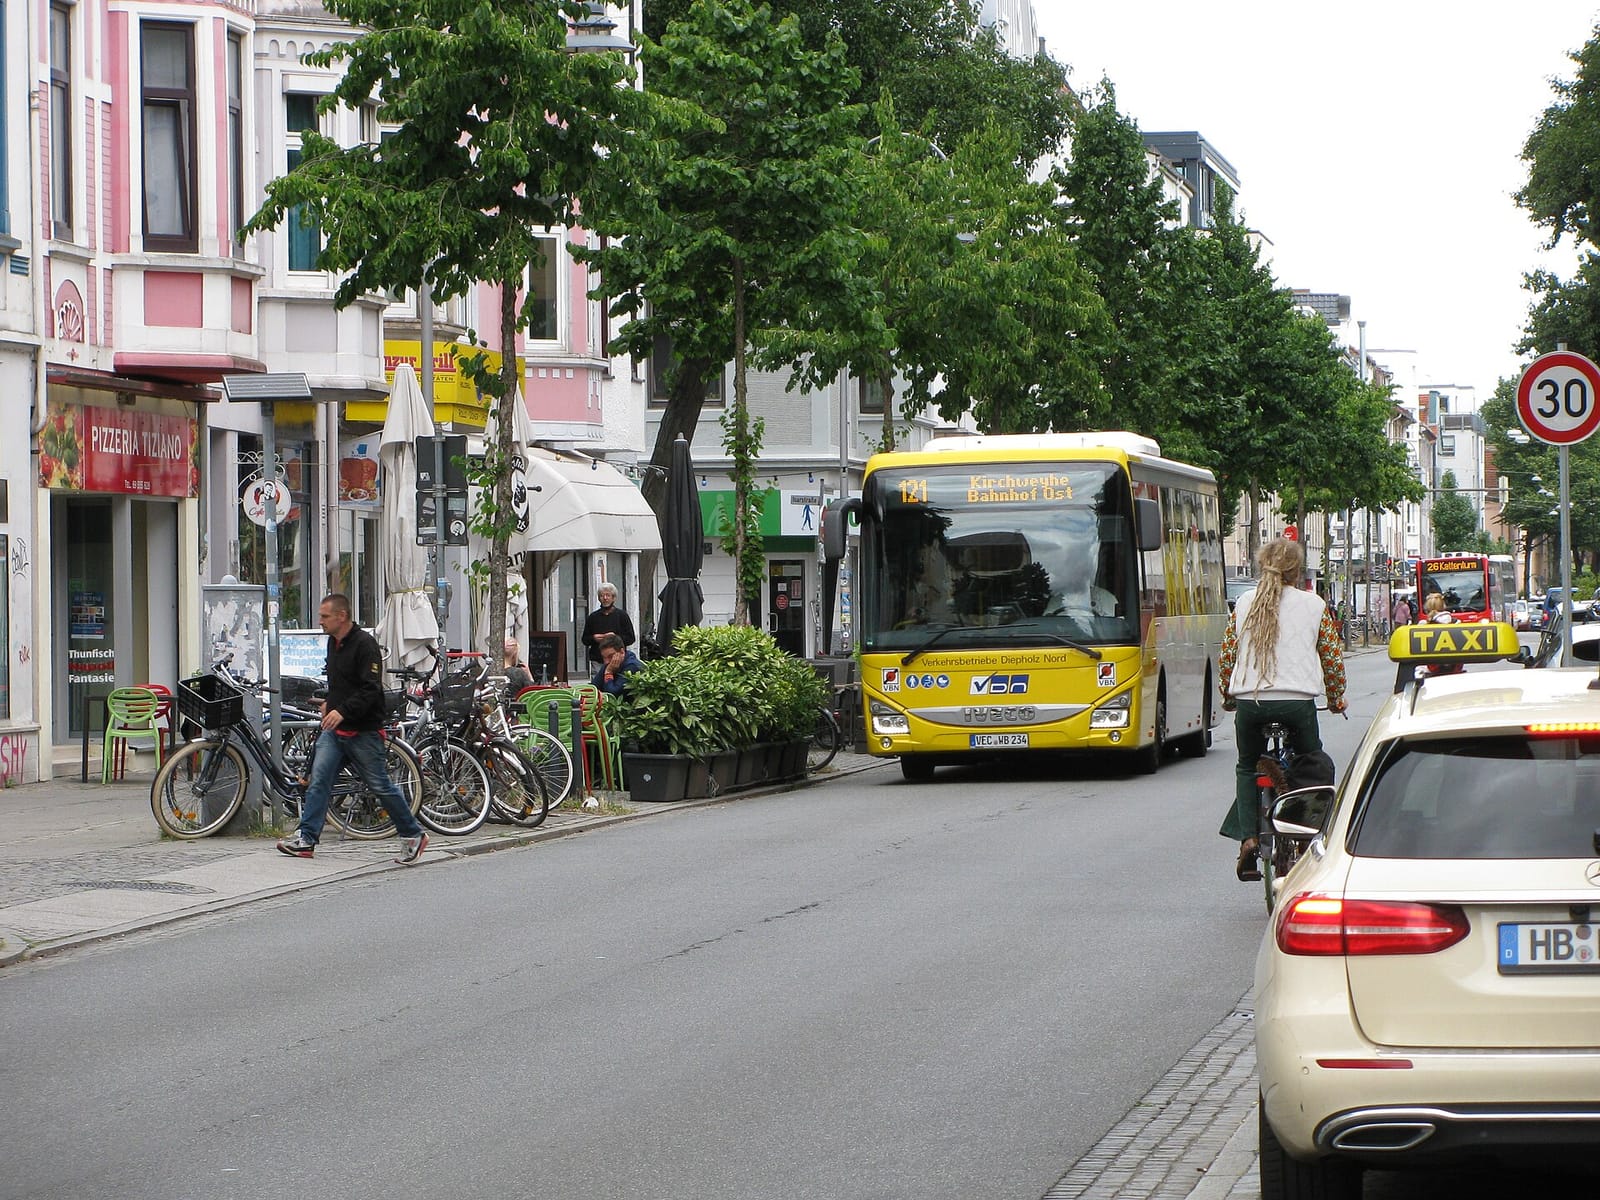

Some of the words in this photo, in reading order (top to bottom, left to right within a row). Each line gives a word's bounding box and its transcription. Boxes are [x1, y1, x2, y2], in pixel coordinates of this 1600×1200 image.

[1537, 378, 1587, 418] 30
[91, 425, 140, 456] PIZZERIA
[142, 431, 182, 460] TIZIANO
[898, 479, 928, 503] 121
[970, 474, 1069, 489] Kirchweyhe
[967, 488, 1037, 503] Bahnhof
[1043, 486, 1073, 500] Ost
[1427, 561, 1440, 572] 26
[1413, 629, 1494, 652] TAXI
[69, 648, 115, 659] Thunfisch
[921, 656, 998, 667] Verkehrsbetriebe
[1001, 654, 1041, 666] Diepholz
[1043, 653, 1067, 663] Nord
[69, 673, 115, 683] Fantasie
[883, 683, 899, 692] VBN
[963, 706, 1036, 723] IVECO
[976, 735, 993, 746] VEC
[1011, 734, 1027, 745] 234
[1530, 928, 1575, 961] HB
